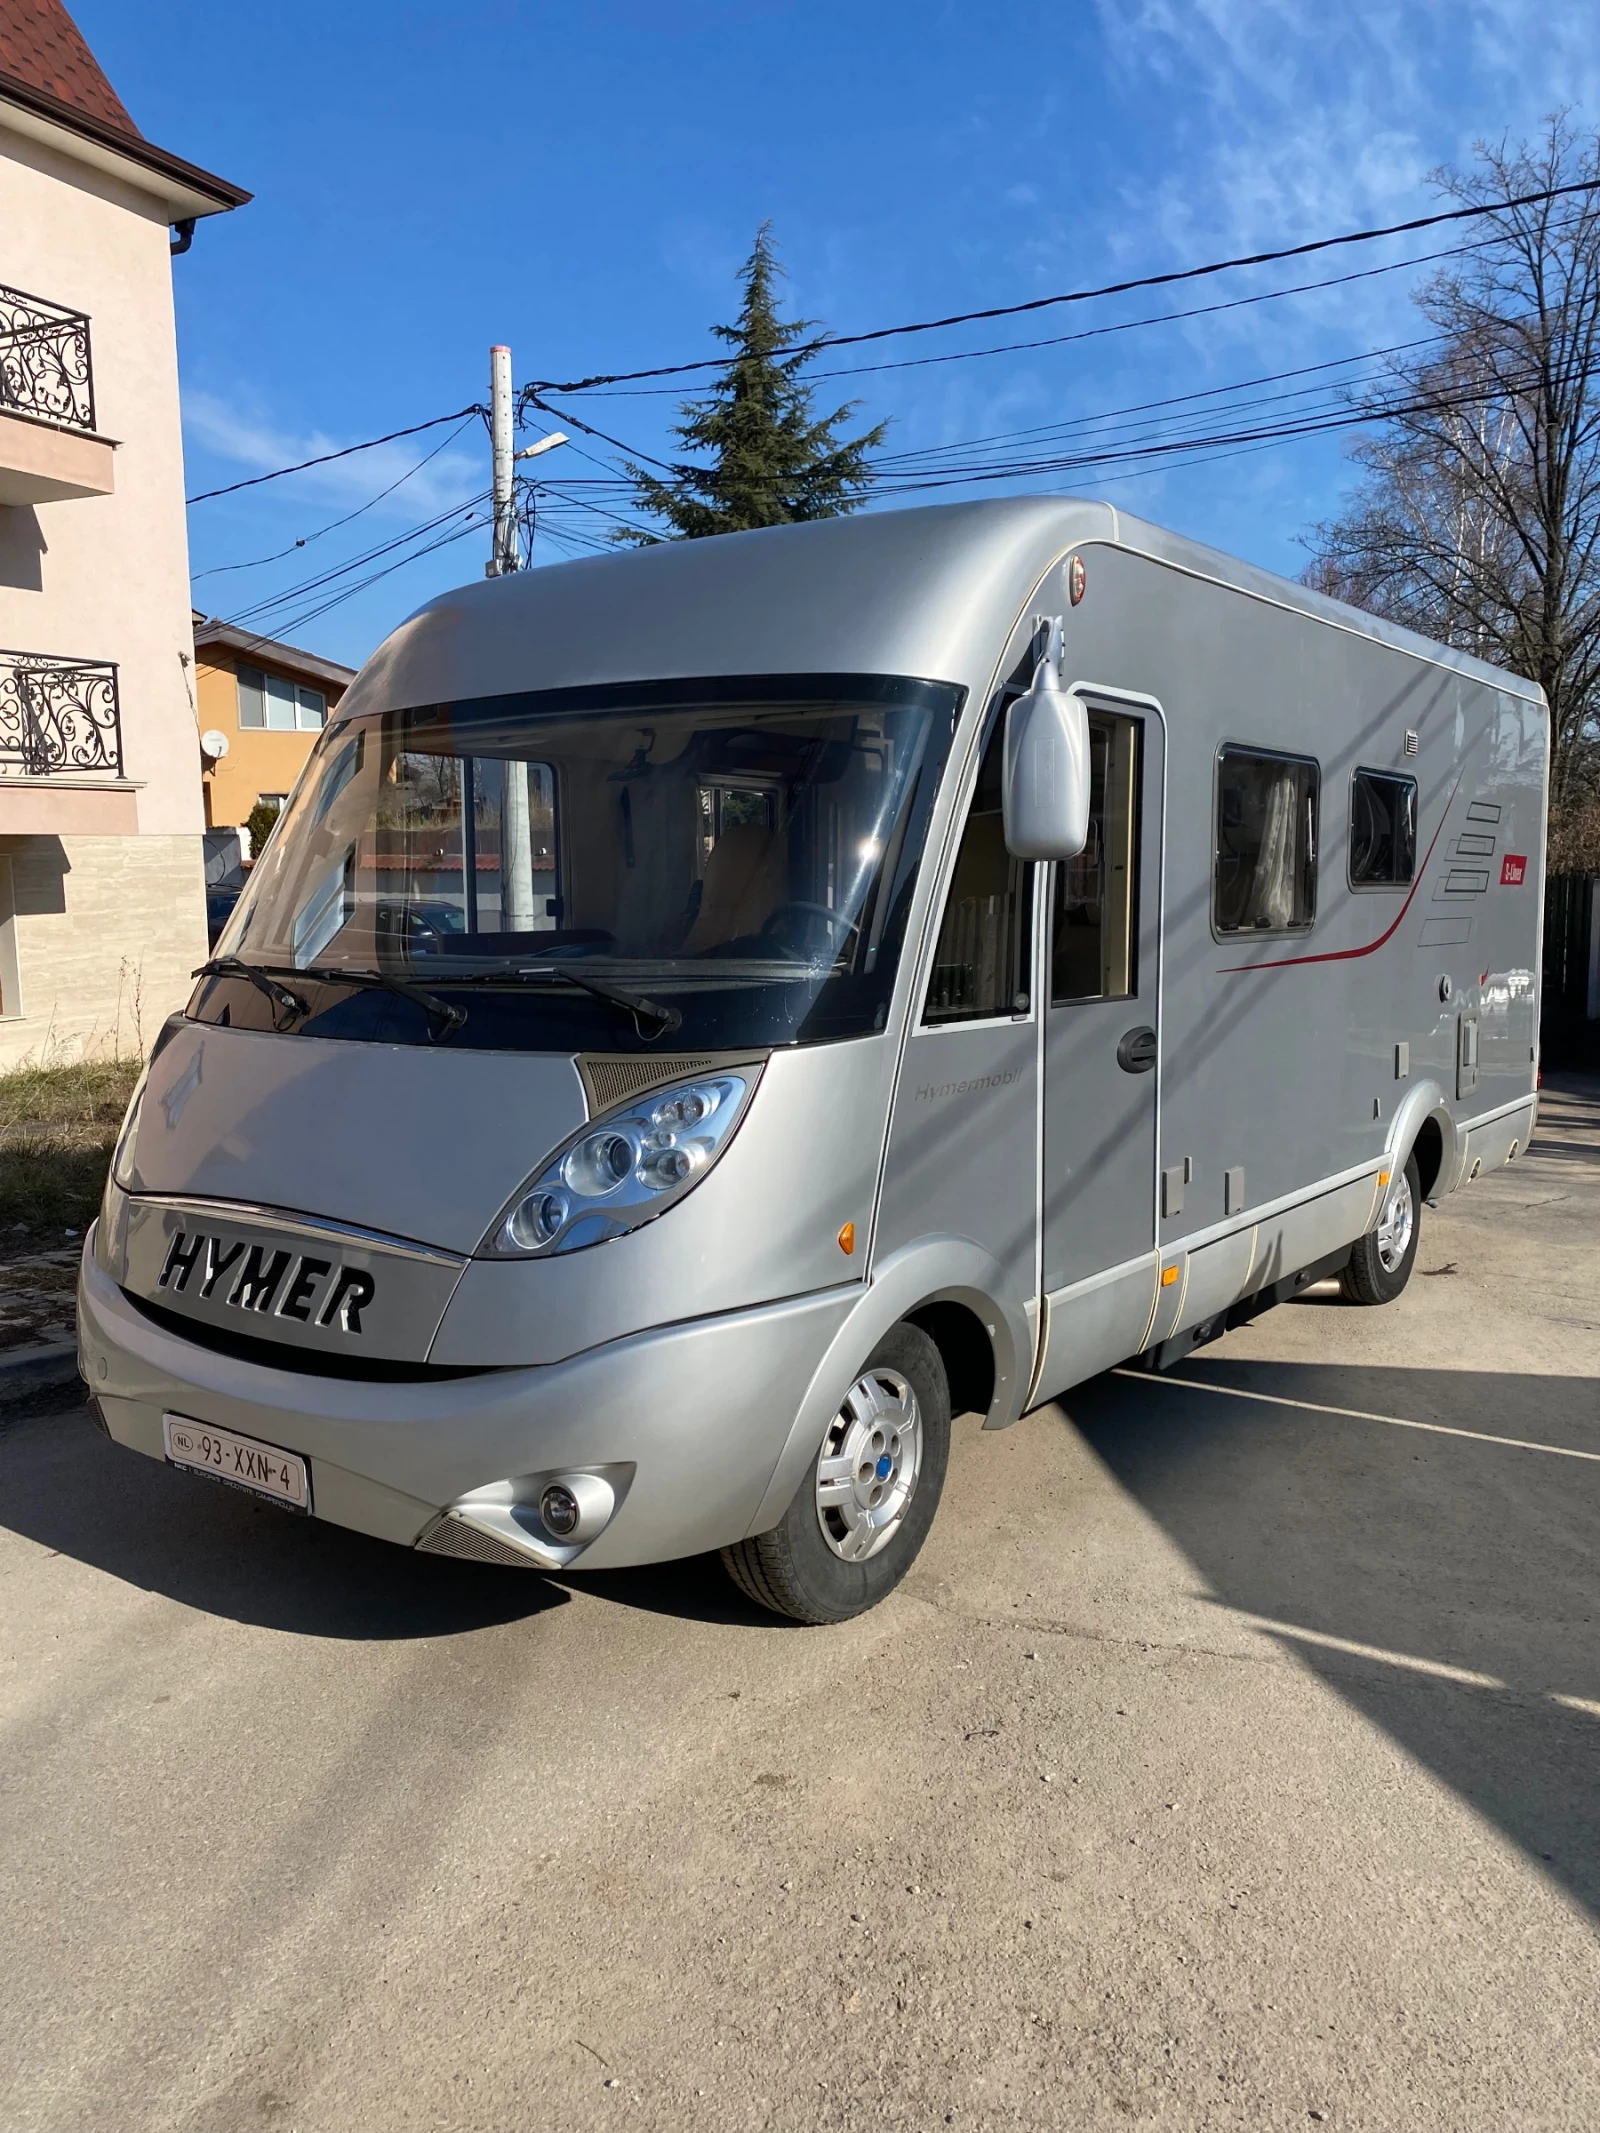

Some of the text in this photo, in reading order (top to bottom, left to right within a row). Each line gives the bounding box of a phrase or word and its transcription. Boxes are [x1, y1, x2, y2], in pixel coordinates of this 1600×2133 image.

[914, 1066, 1023, 1103] Hymermobil
[158, 1230, 376, 1335] HYMER
[177, 1435, 291, 1491] NL 93-XXN-4
